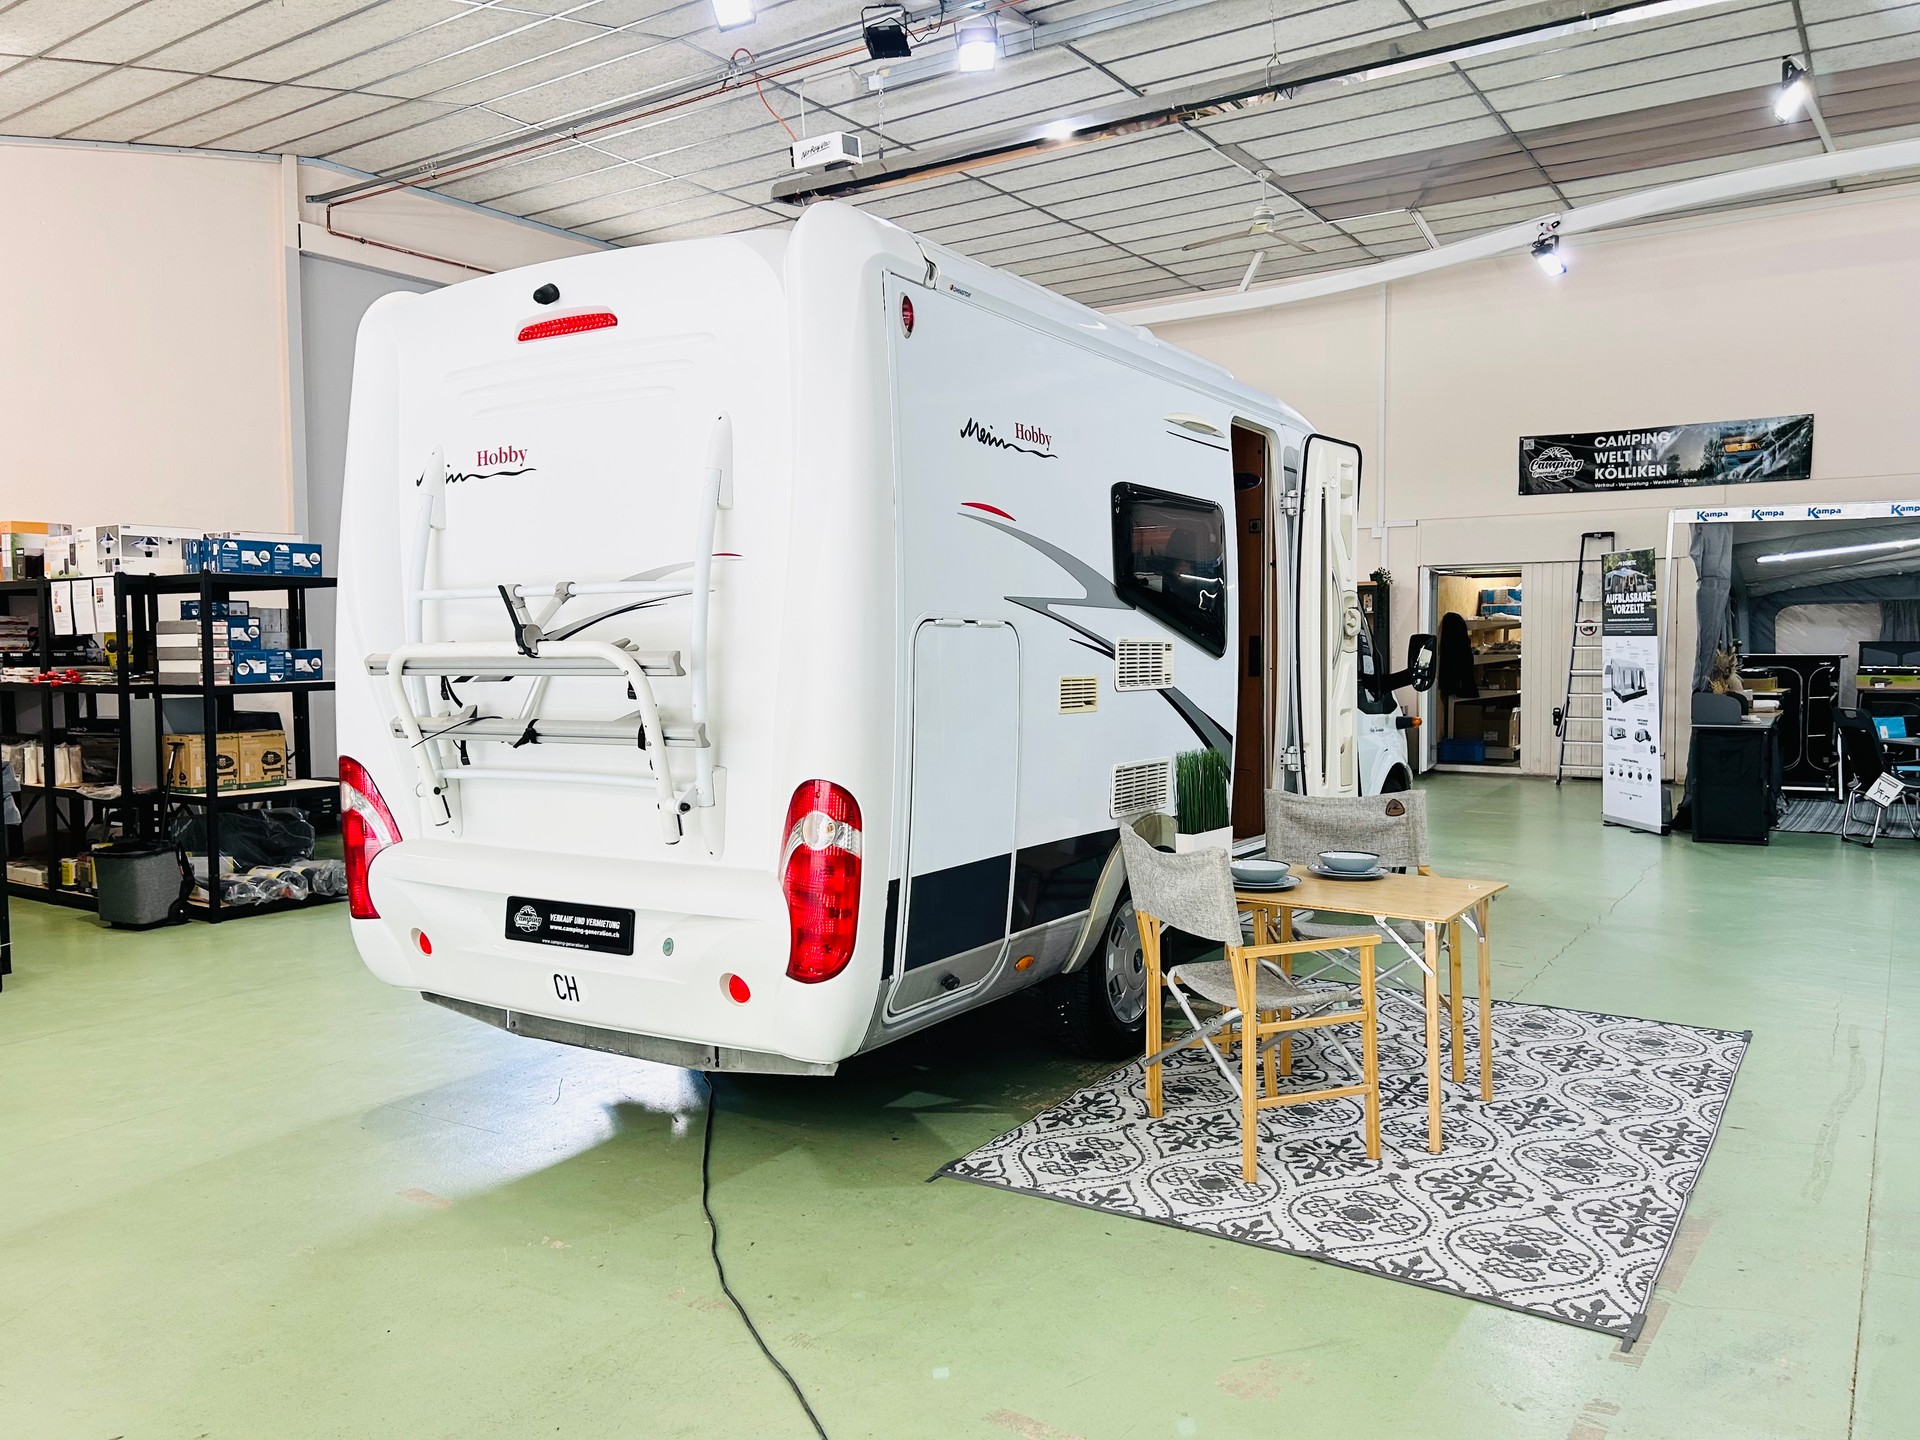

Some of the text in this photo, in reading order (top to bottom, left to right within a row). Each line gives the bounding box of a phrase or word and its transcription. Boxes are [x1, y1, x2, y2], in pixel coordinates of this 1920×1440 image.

[1014, 422, 1052, 451] Hobby
[1594, 431, 1671, 448] CAMPING
[476, 445, 528, 467] Hobby
[1594, 449, 1652, 464] WELT IN
[1529, 458, 1584, 472] Camping
[1594, 464, 1668, 480] KÖLLIKEN
[1697, 510, 1728, 522] Kampa
[1751, 509, 1784, 521] Kampa
[1807, 507, 1842, 519] Kampa
[1891, 504, 1920, 516] Kamp
[1605, 592, 1651, 604] AUFBLASBARE
[1612, 603, 1645, 615] VORZELTE
[550, 913, 621, 930] VERKAUF UND VERMIETUNG
[549, 925, 620, 938] www.camping-generation.ch
[553, 973, 580, 1002] CH
